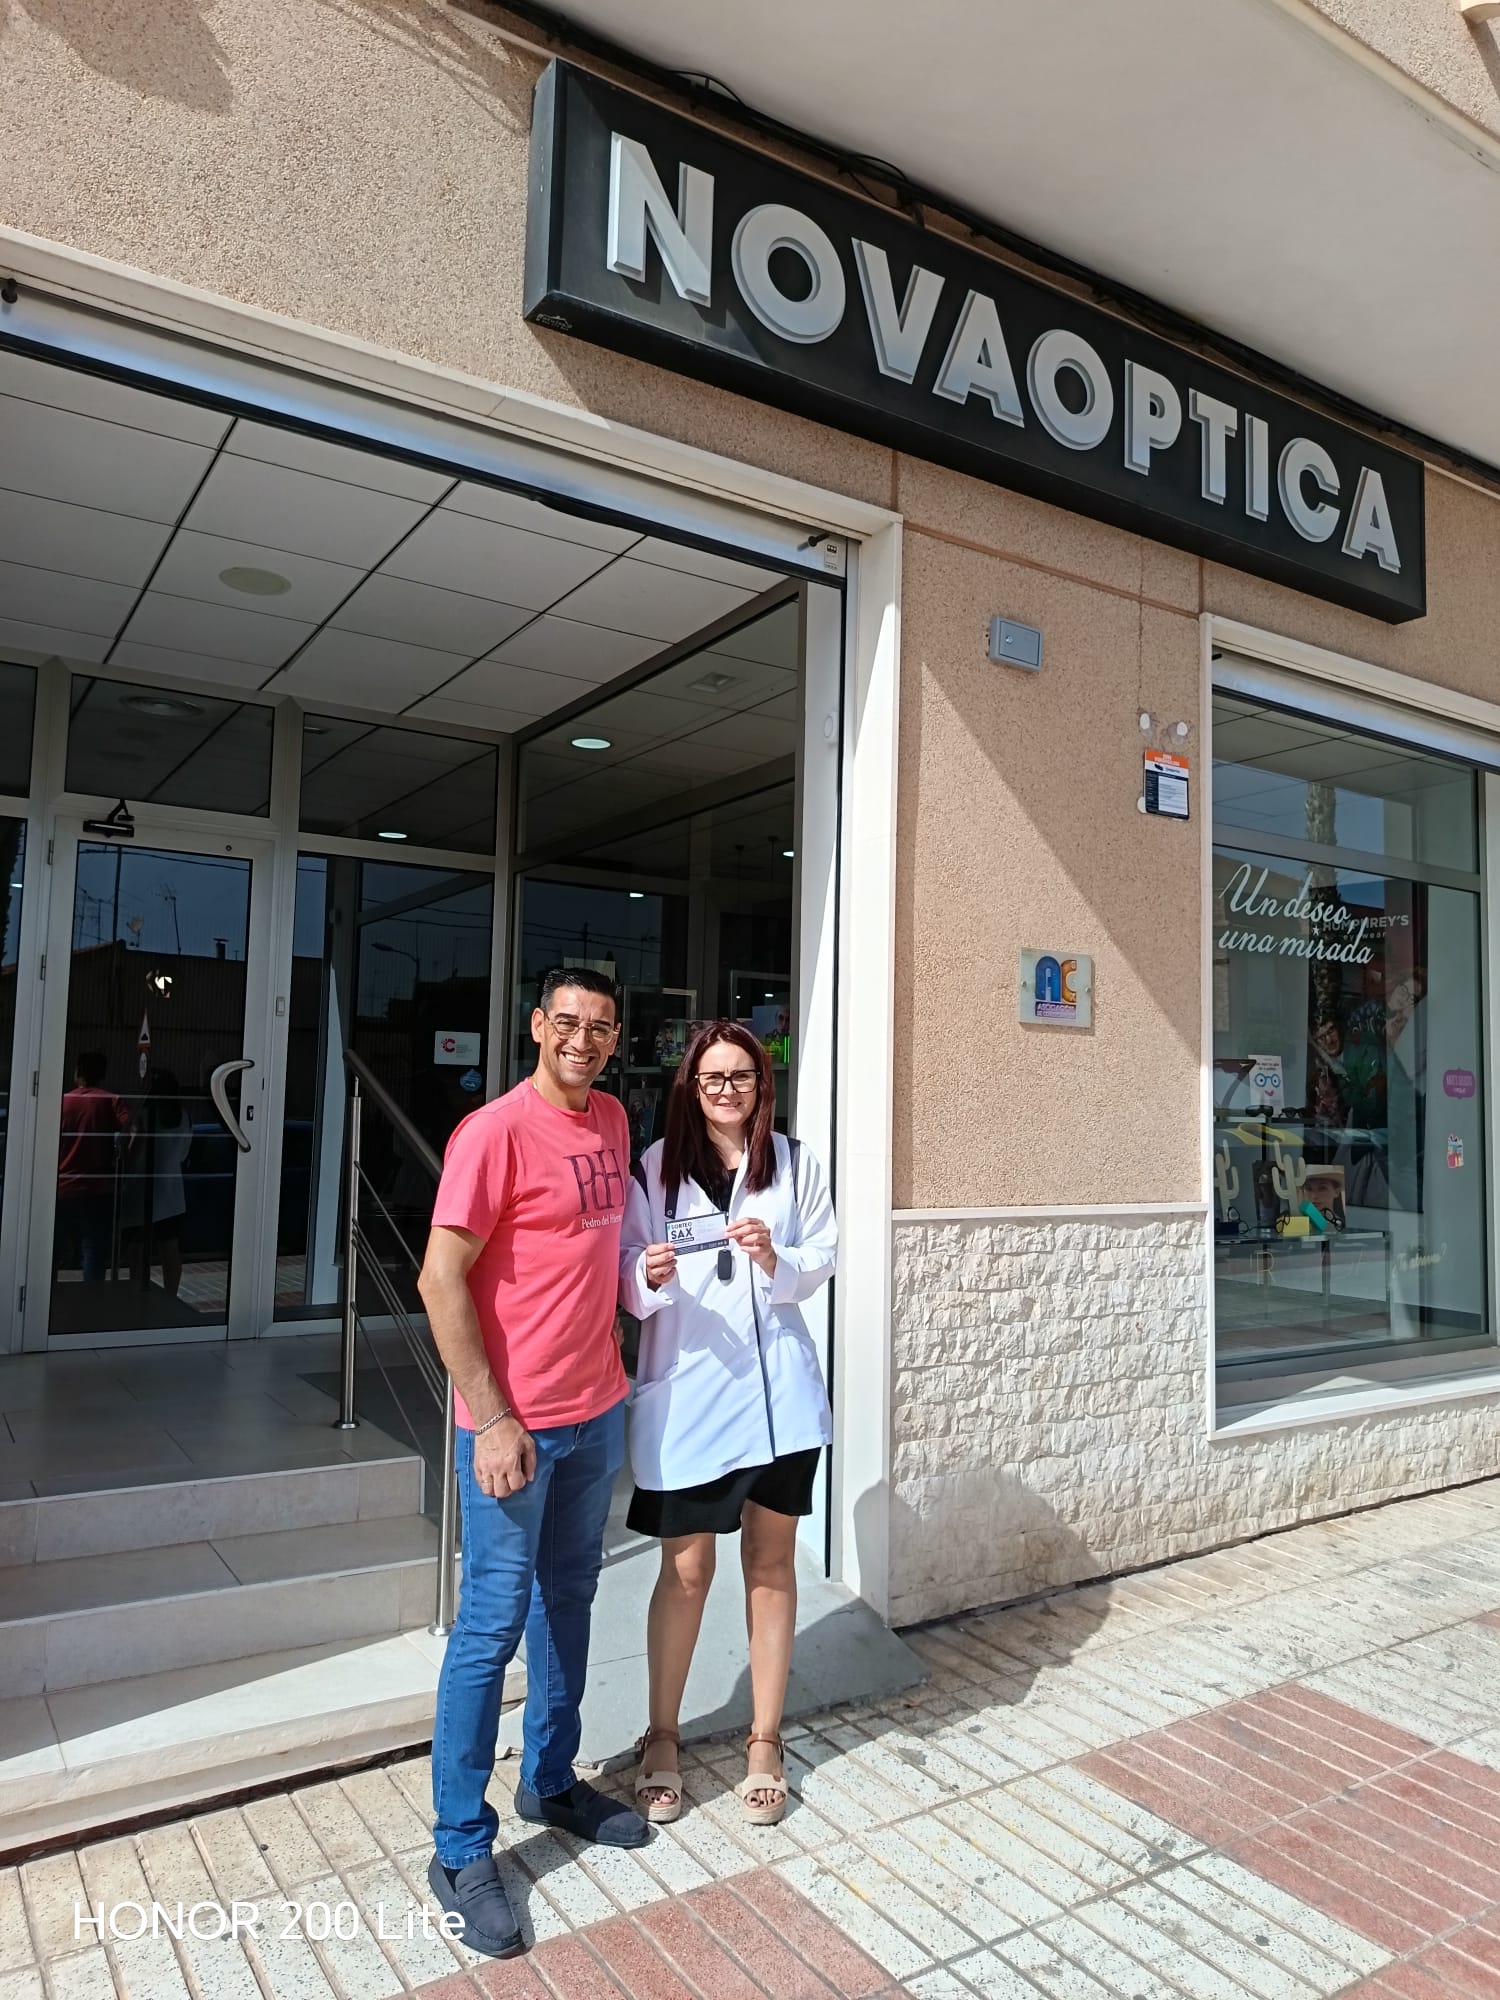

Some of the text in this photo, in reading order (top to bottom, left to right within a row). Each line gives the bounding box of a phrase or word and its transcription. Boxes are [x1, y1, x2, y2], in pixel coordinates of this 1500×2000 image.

[605, 130, 1401, 574] NOVAOPTICA
[1218, 863, 1355, 935] Un deseo,
[1218, 917, 1375, 965] una mirada
[1343, 932, 1387, 942] eywear
[581, 1216, 601, 1230] Pedro
[601, 1214, 610, 1226] del
[671, 1221, 693, 1230] SORTEO
[670, 1227, 693, 1240] SAX
